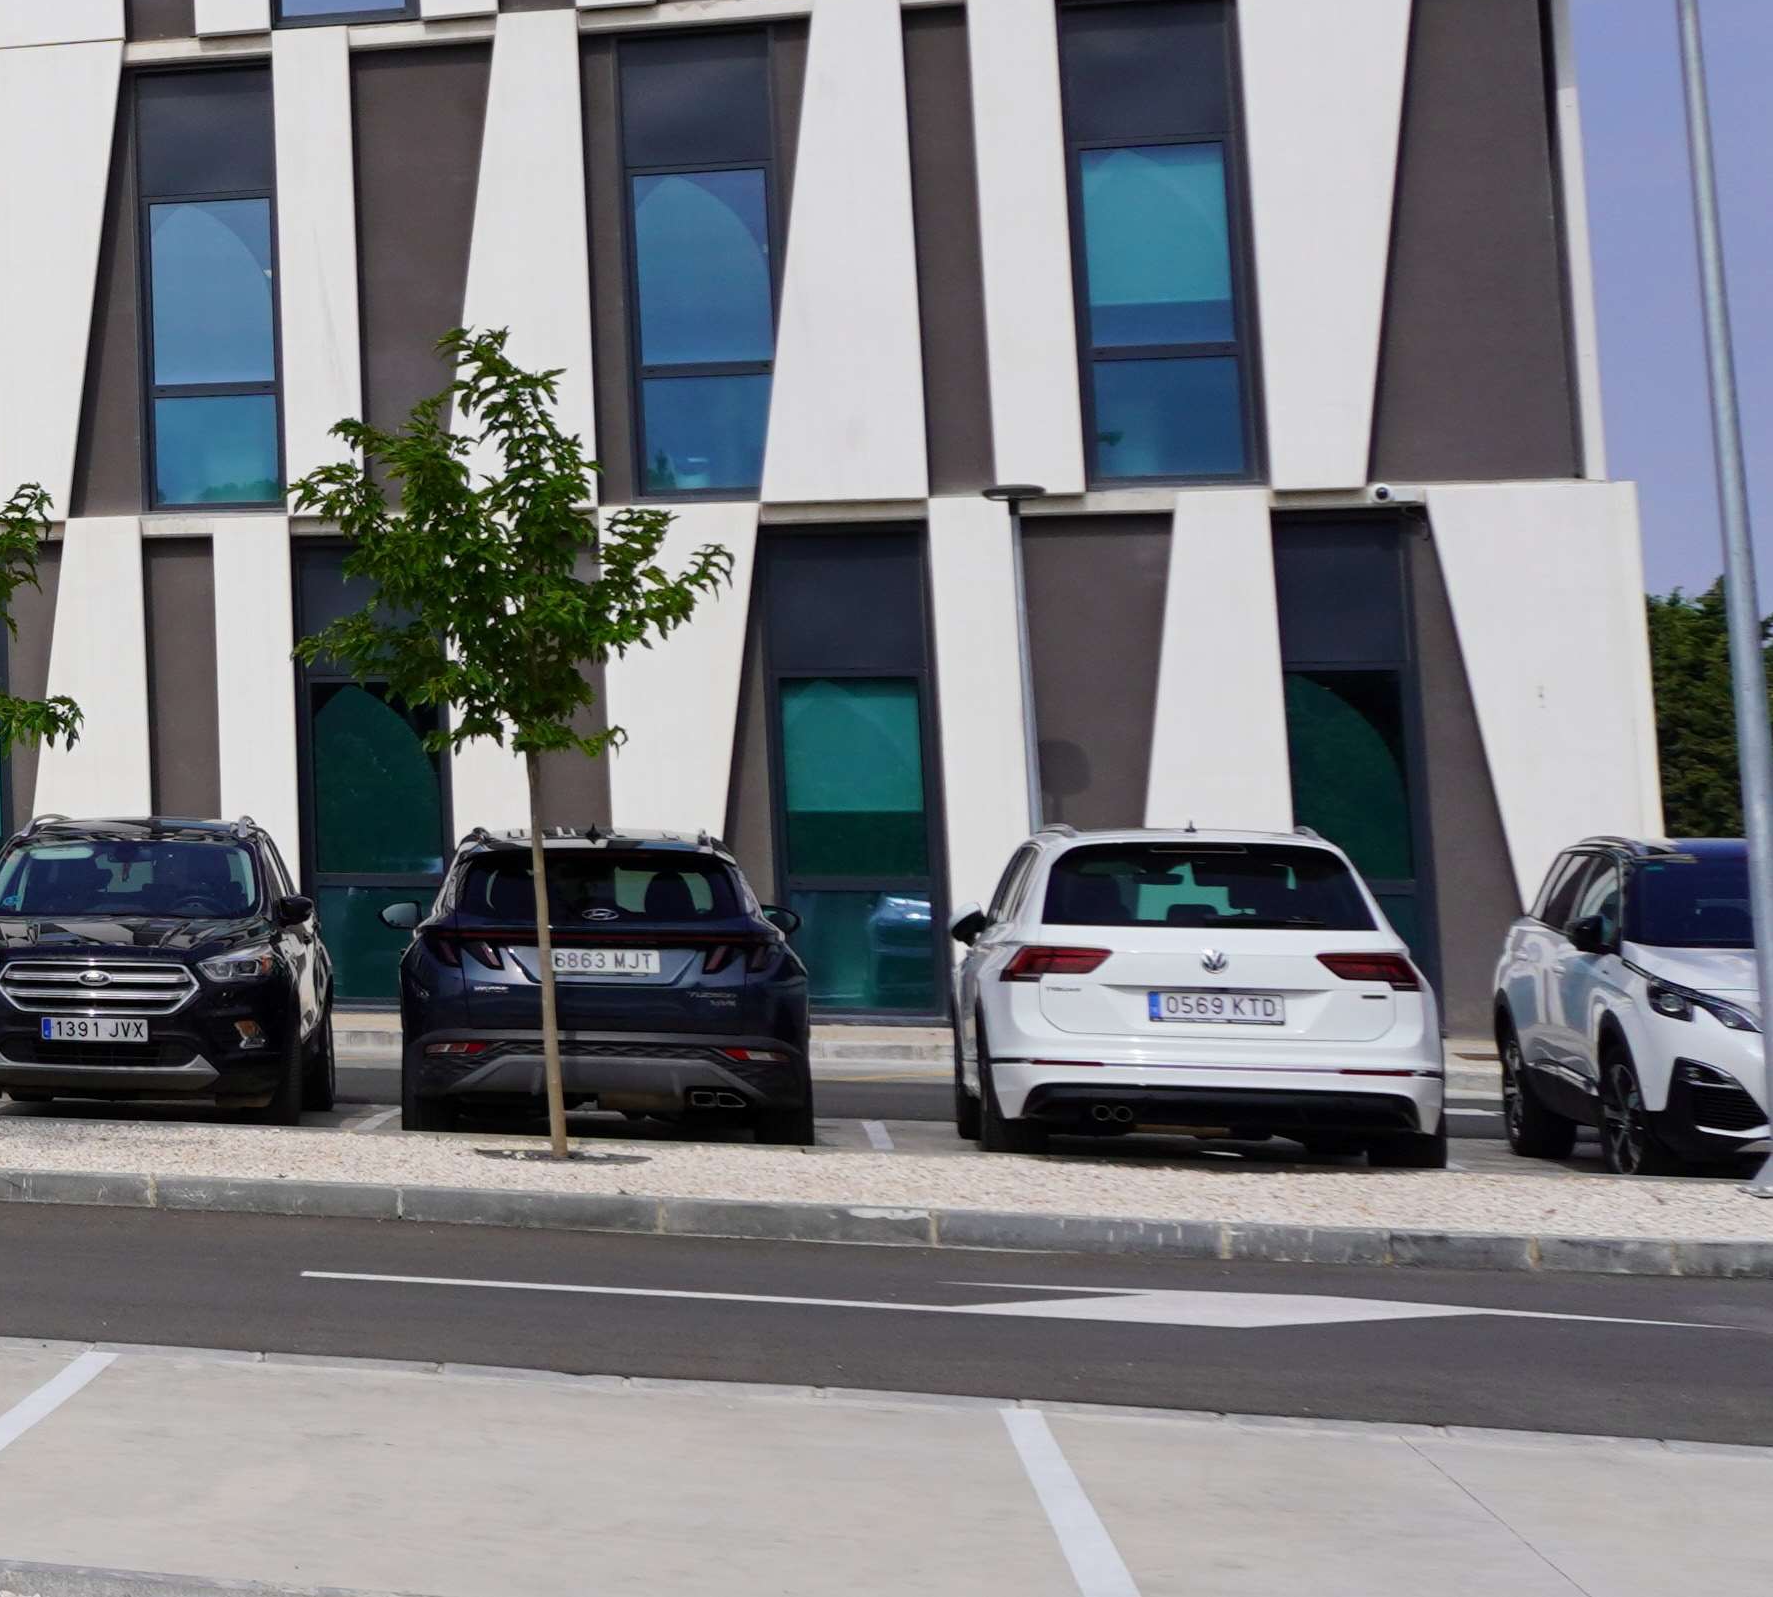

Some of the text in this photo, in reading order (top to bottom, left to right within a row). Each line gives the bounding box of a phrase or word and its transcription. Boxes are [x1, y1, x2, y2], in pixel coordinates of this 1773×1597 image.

[555, 953, 653, 970] 6863 MJT
[1166, 996, 1276, 1017] 0569 KTD
[56, 1021, 144, 1038] 1391 JVX
